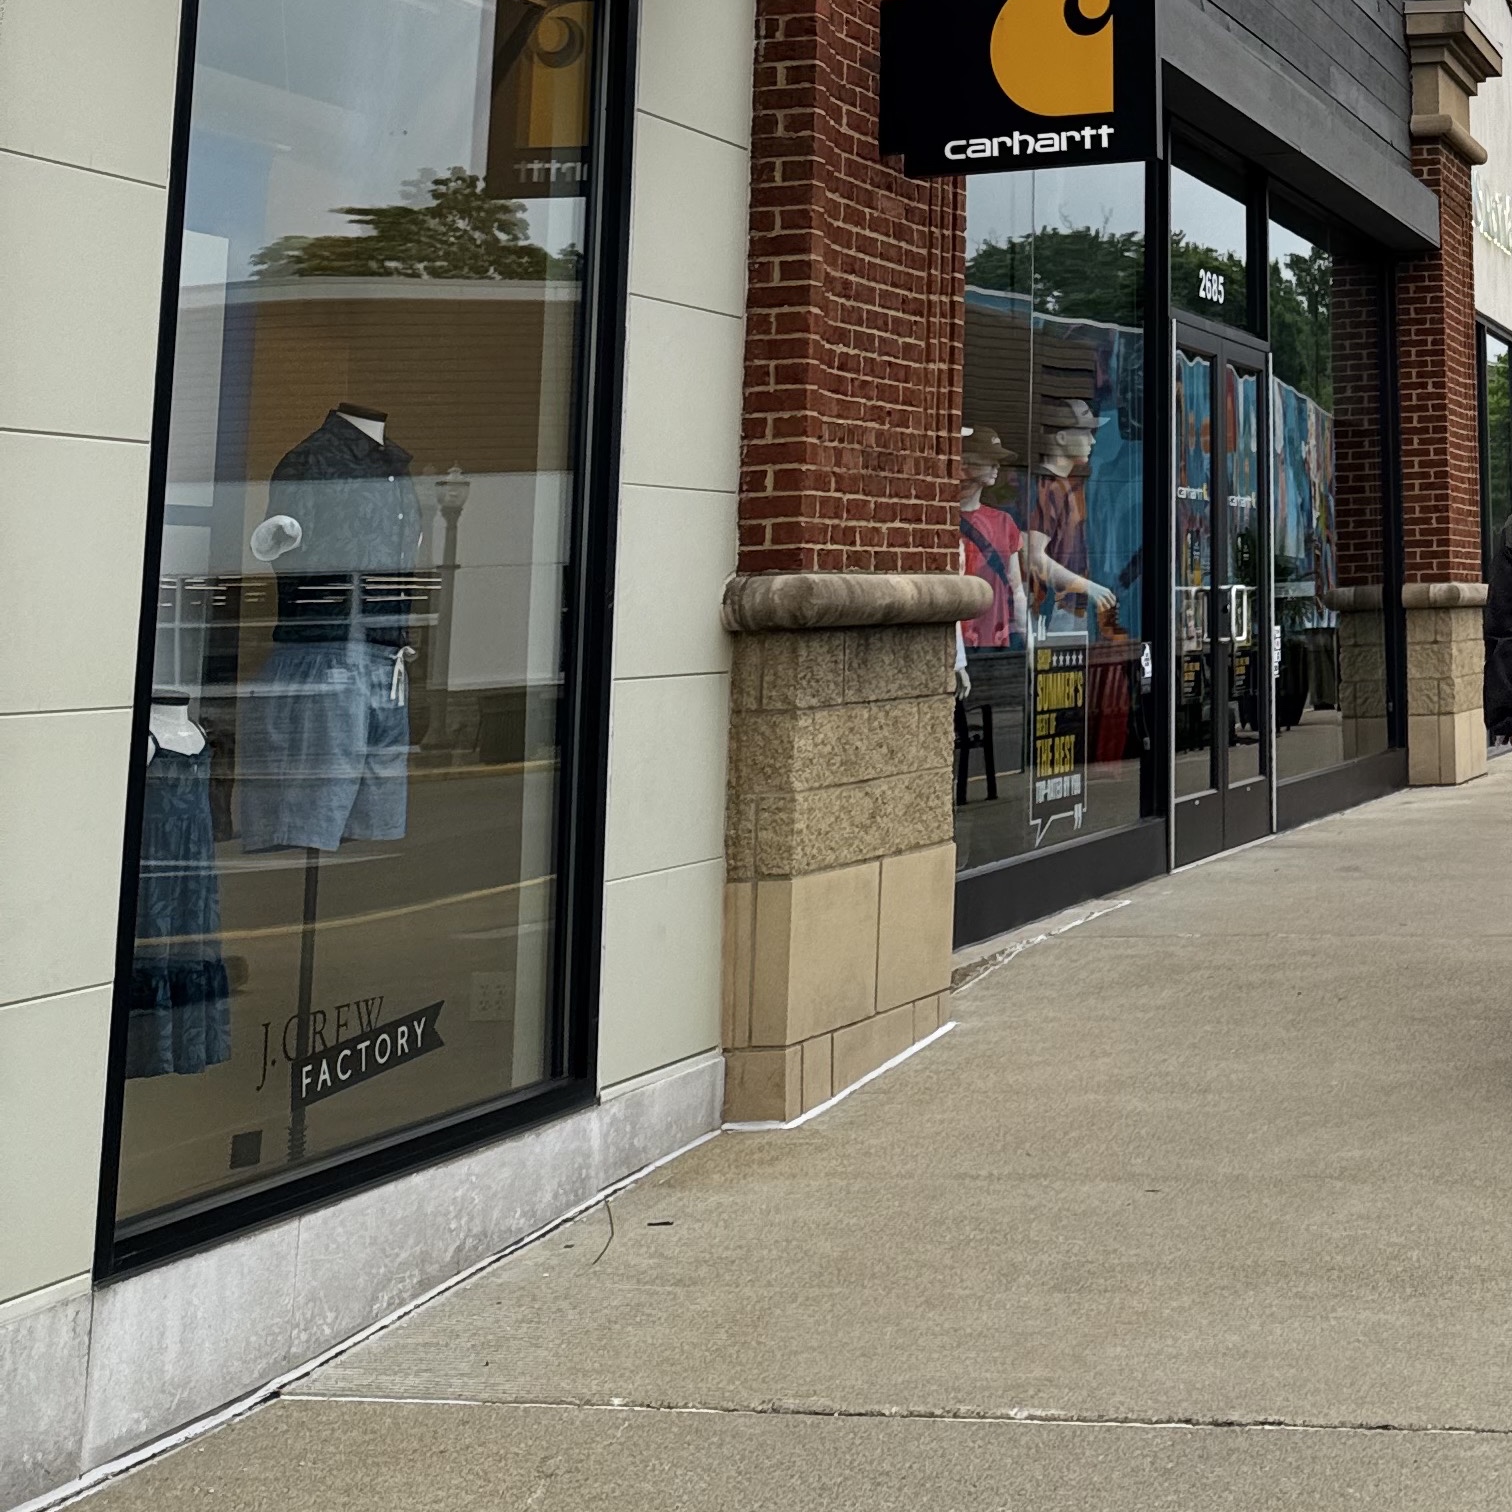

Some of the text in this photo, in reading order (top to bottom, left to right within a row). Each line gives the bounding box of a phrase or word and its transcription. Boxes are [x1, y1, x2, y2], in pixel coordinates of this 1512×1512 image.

[944, 124, 1115, 160] carhartt
[1198, 268, 1225, 305] 2685
[1036, 671, 1084, 712] SUMMER'S
[1036, 734, 1076, 778] THE BEST
[301, 1016, 427, 1098] FACTORY
